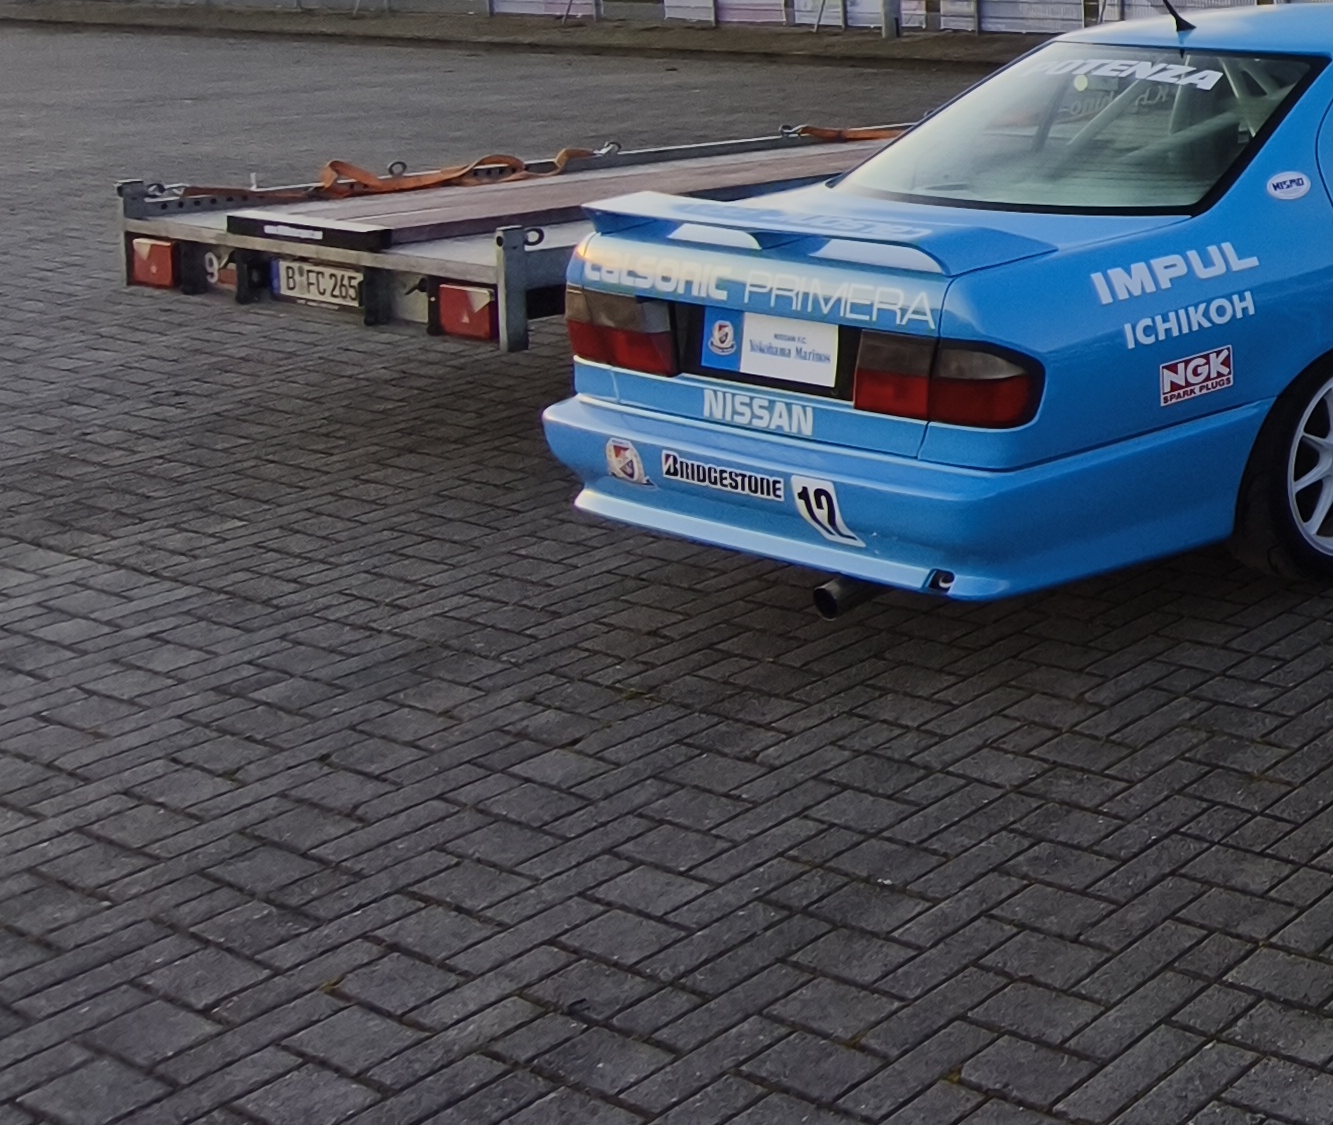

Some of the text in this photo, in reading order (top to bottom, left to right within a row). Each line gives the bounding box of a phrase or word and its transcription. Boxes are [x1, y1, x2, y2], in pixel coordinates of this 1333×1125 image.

[285, 266, 360, 302] B FC 265
[1090, 242, 1259, 305] IMPUL
[744, 273, 936, 329] PRIMERA
[1123, 290, 1256, 350] ICHIKOH
[794, 346, 831, 363] Marinos
[1163, 348, 1232, 394] NGK
[703, 388, 814, 437] NISSAN
[1163, 376, 1232, 404] SPARK PLUGS
[662, 451, 783, 500] BRIDGESTONE
[797, 483, 857, 541] 12
